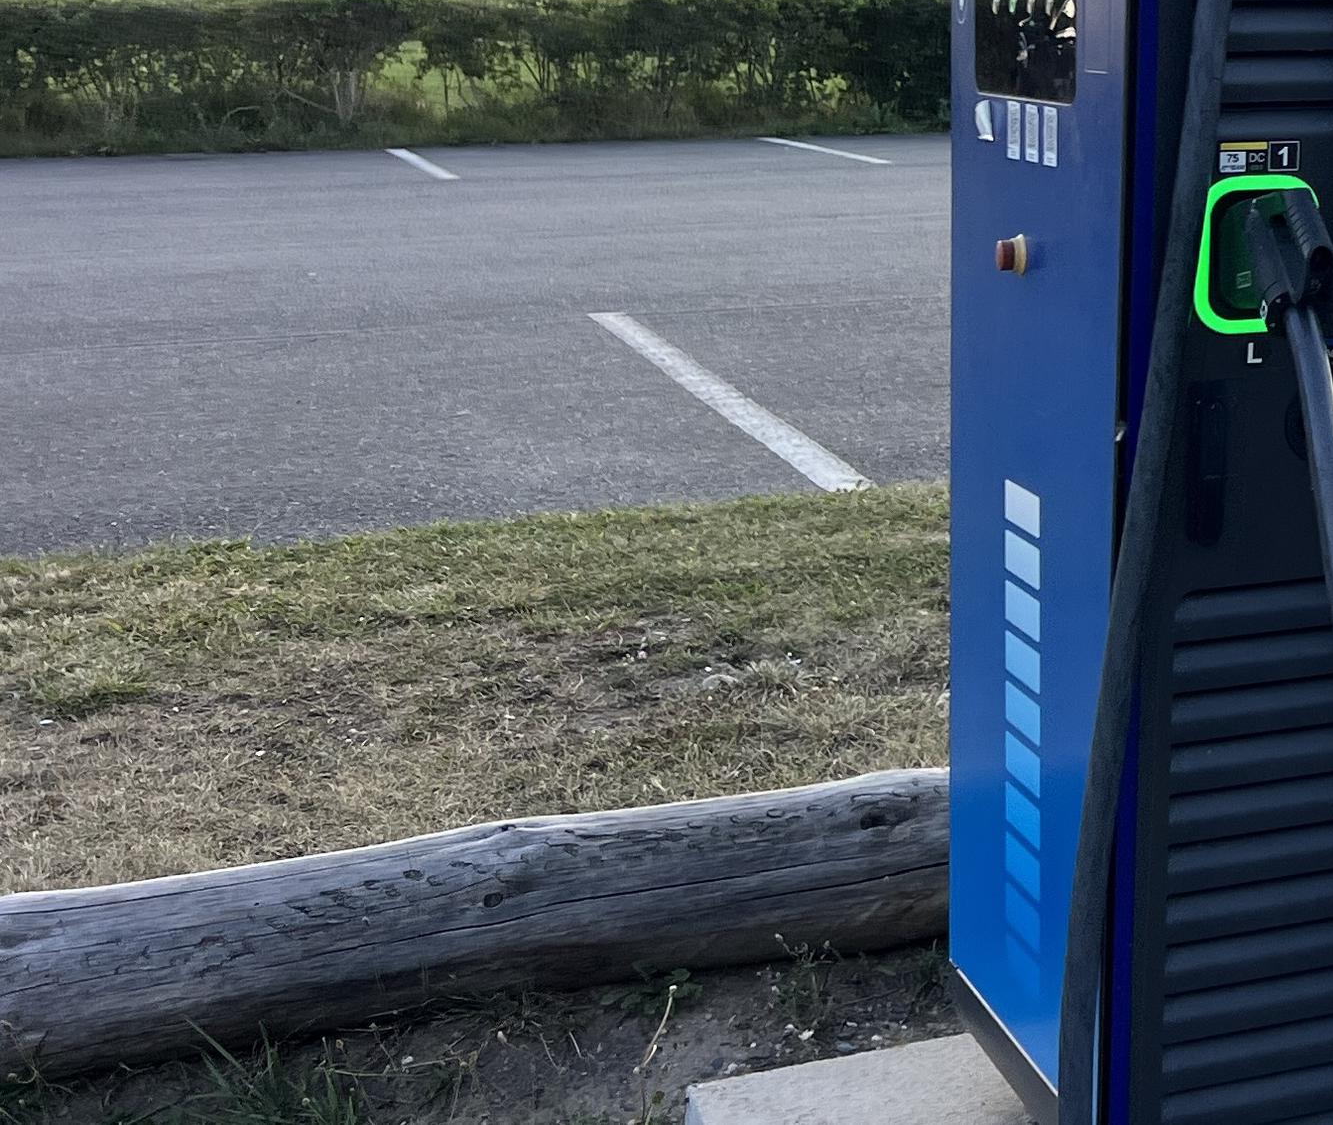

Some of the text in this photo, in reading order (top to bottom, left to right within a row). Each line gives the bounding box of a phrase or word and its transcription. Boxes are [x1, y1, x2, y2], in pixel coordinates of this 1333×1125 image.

[1249, 153, 1266, 163] DC
[1277, 146, 1289, 167] 1
[1246, 342, 1263, 364] L
